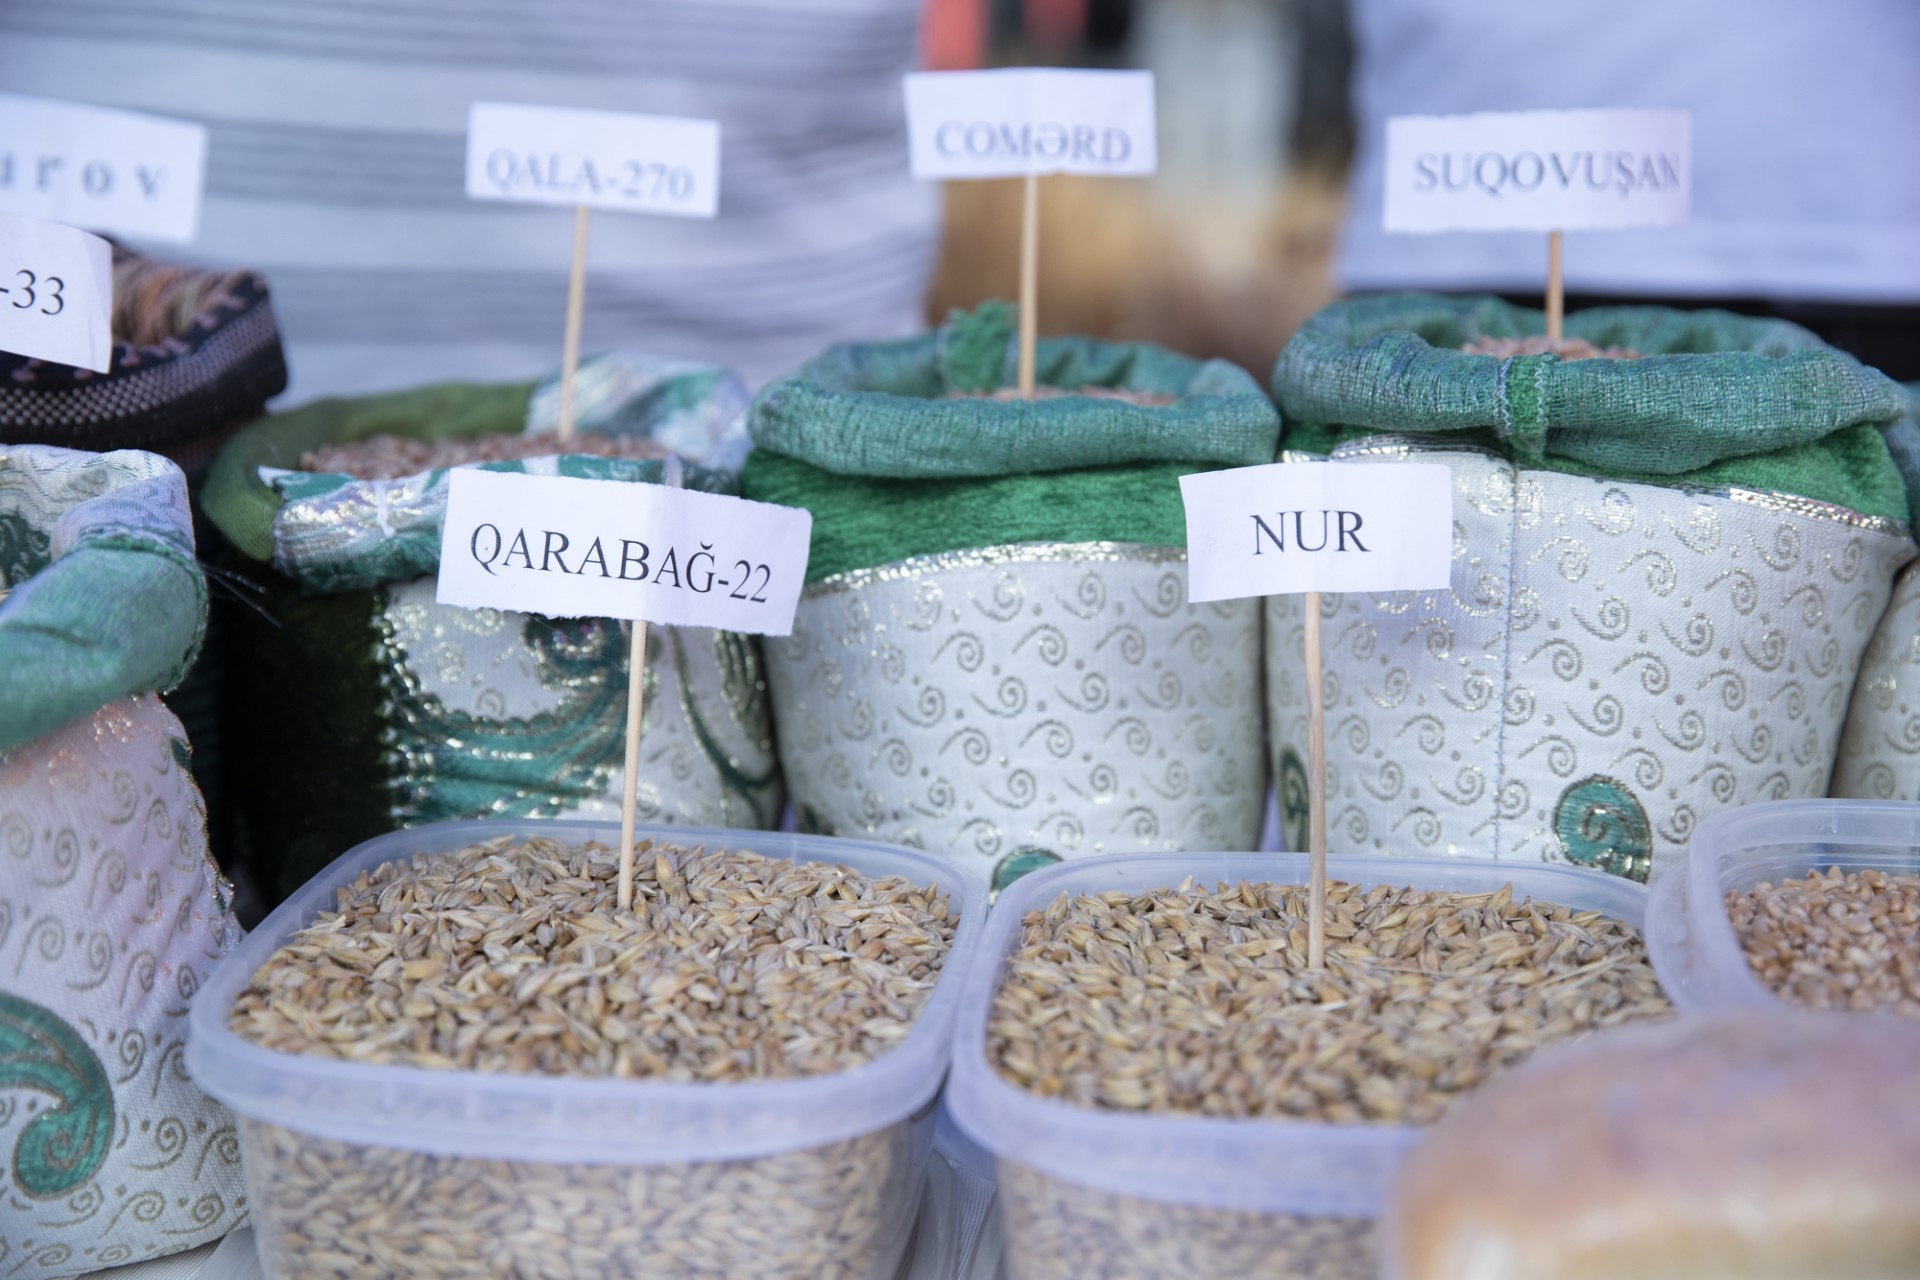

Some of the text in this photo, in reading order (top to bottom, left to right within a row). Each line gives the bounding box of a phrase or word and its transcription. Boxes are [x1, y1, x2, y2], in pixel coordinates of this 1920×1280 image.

[935, 120, 1132, 164] COMƏRD
[486, 147, 696, 202] QALA-270
[1413, 151, 1681, 200] SUQOVUŞAN
[1249, 509, 1373, 556] NUR
[470, 522, 772, 603] QARABAĞ-22
